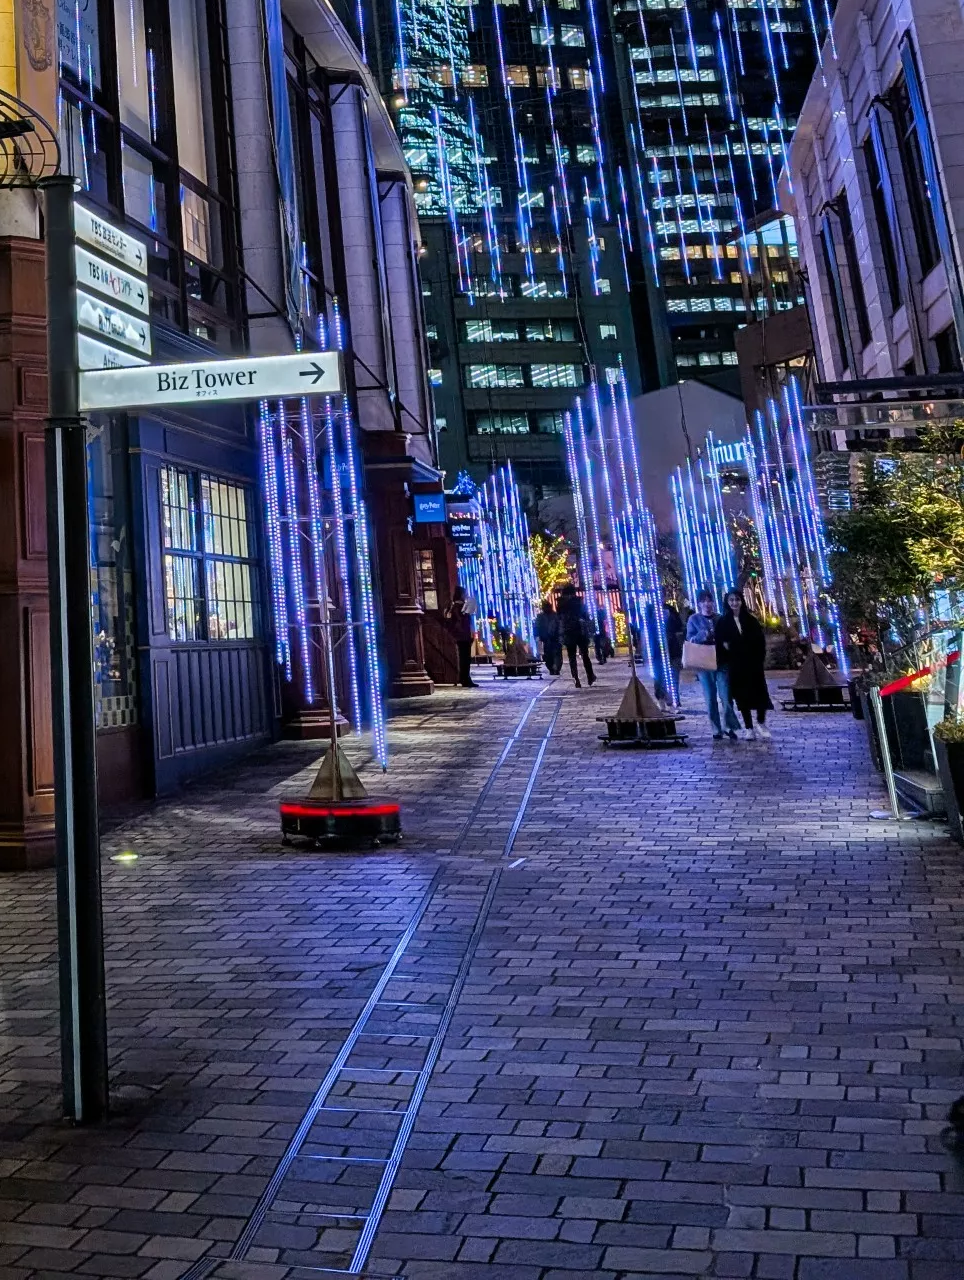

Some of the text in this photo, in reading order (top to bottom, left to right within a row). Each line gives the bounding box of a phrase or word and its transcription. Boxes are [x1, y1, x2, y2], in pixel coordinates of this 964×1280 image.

[157, 368, 258, 392] Biz Tower
[195, 389, 219, 397] オフィス
